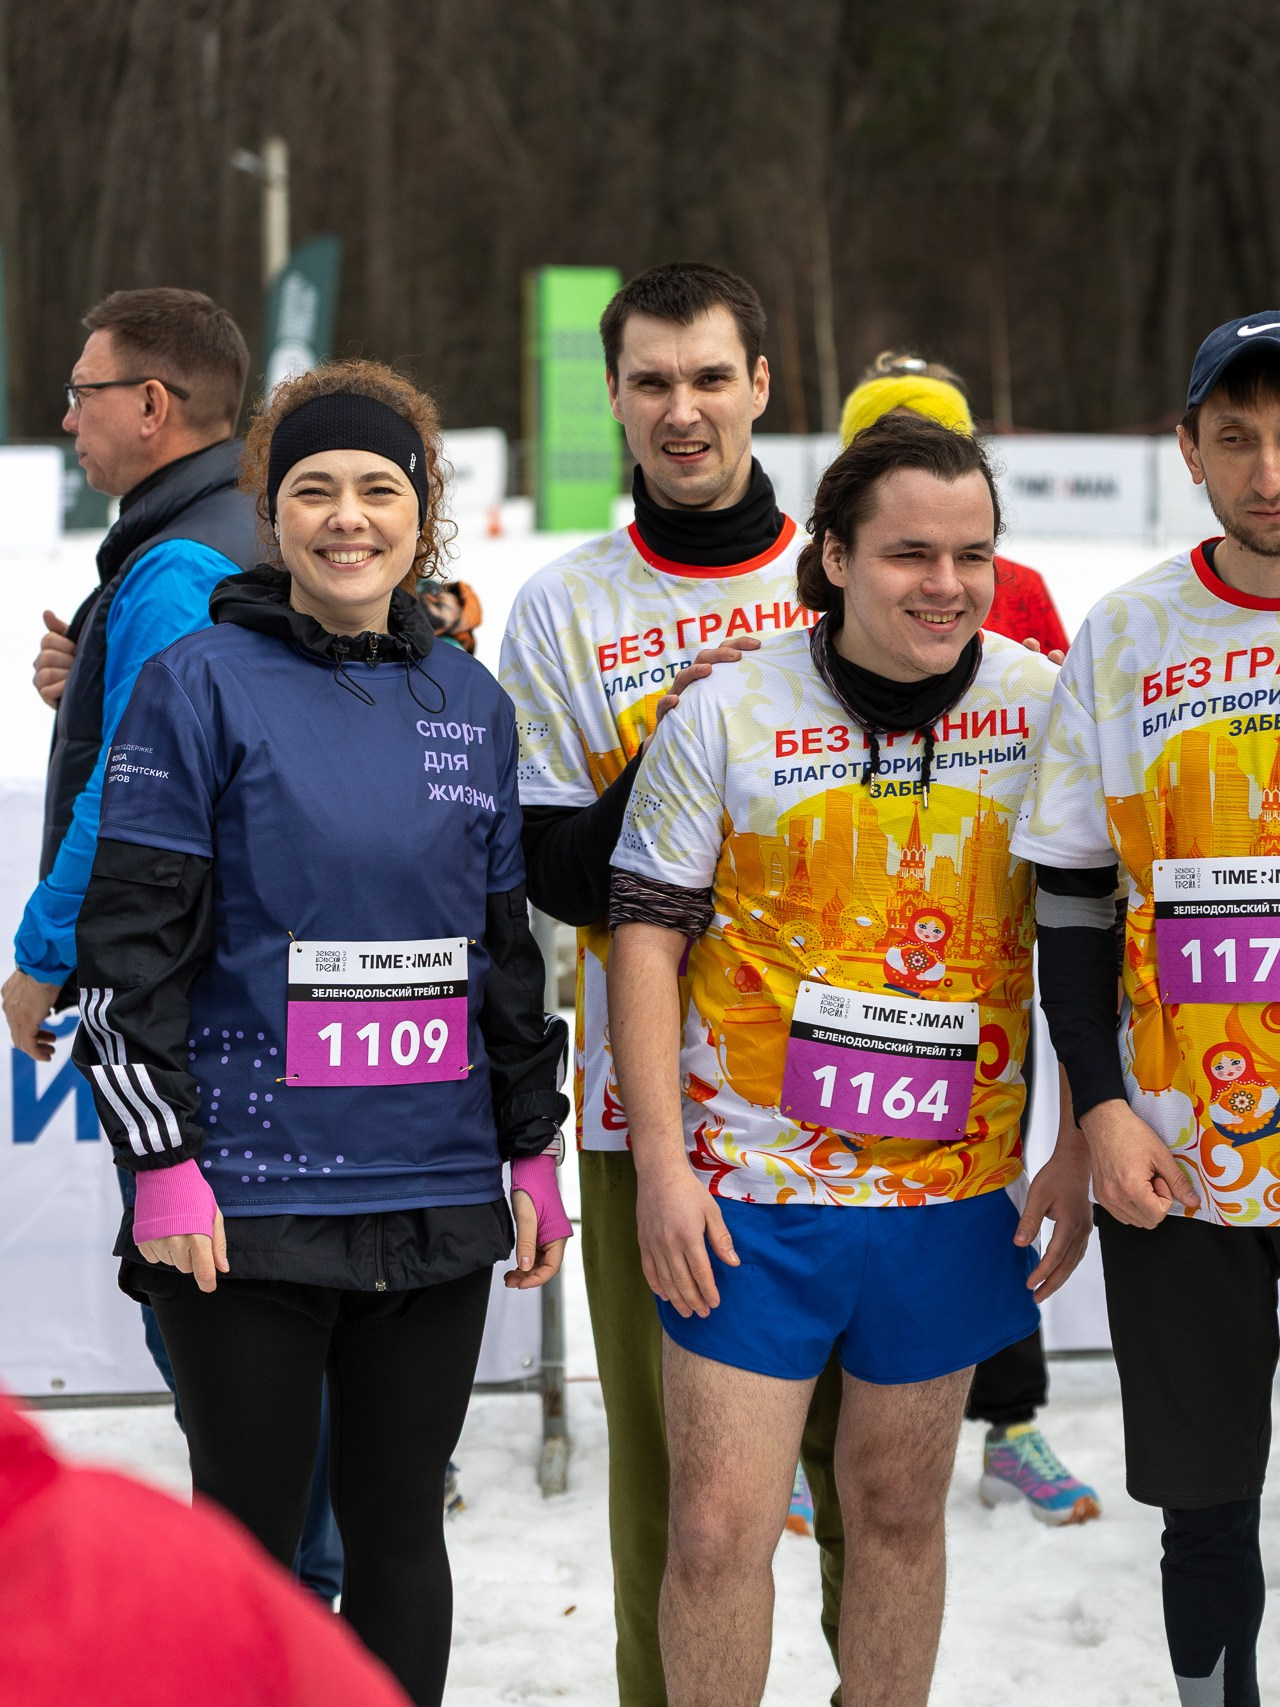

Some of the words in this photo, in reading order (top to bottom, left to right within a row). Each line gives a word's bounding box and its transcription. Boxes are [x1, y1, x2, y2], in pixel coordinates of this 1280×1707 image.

[598, 627, 665, 673] БЕЗ
[1143, 656, 1212, 707] БЕЗ
[773, 741, 1027, 787] БЛАГОТОРИЕЛЬНЫЙ
[775, 725, 850, 758] БЕЗ
[1173, 902, 1270, 916] ЗЕЛЕНОДОЛЬСКИЙ
[311, 985, 412, 999] ЗЕЛЕНОДОЛЬСКИЙ
[413, 985, 441, 997] ТРЕЙЛ
[317, 1018, 449, 1067] 1109
[812, 1029, 914, 1054] ЗЕЛЕНОДОЛЬСКИЙ
[915, 1045, 946, 1057] ТРЕЙЛ
[812, 1064, 950, 1122] 1164
